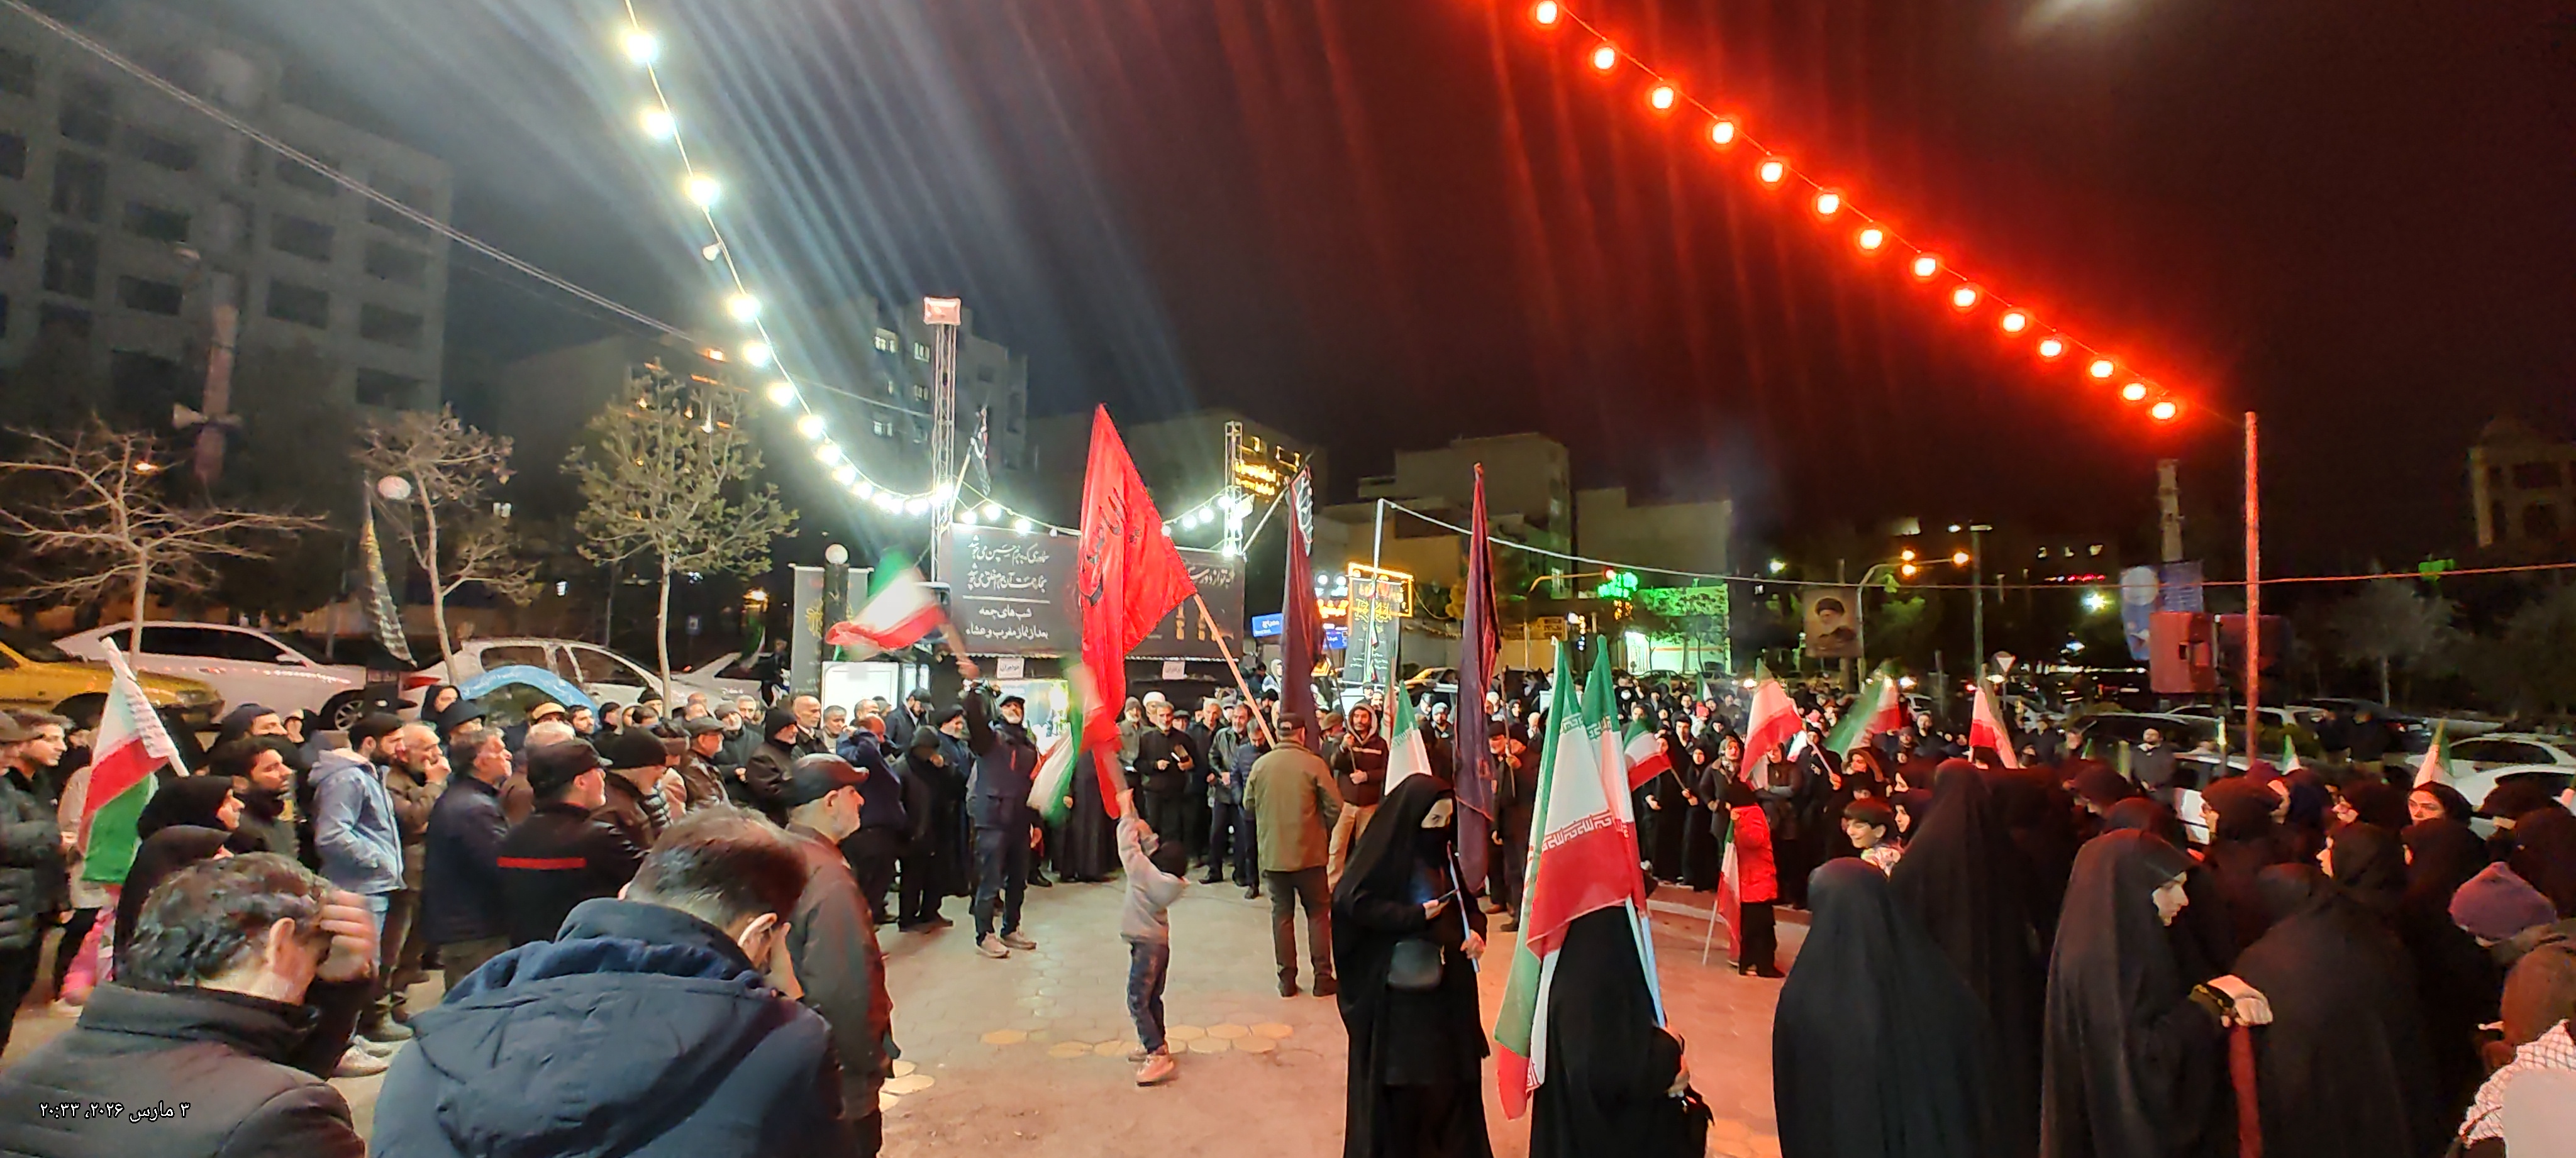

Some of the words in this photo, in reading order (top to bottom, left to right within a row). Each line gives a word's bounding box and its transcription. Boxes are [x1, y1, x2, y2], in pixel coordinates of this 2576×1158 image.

[985, 544, 1019, 563] حسین
[979, 606, 997, 621] جمعه
[985, 628, 992, 639] و
[992, 626, 1016, 640] مغرب
[1015, 624, 1028, 640] نماز
[1037, 629, 1049, 640] بعد
